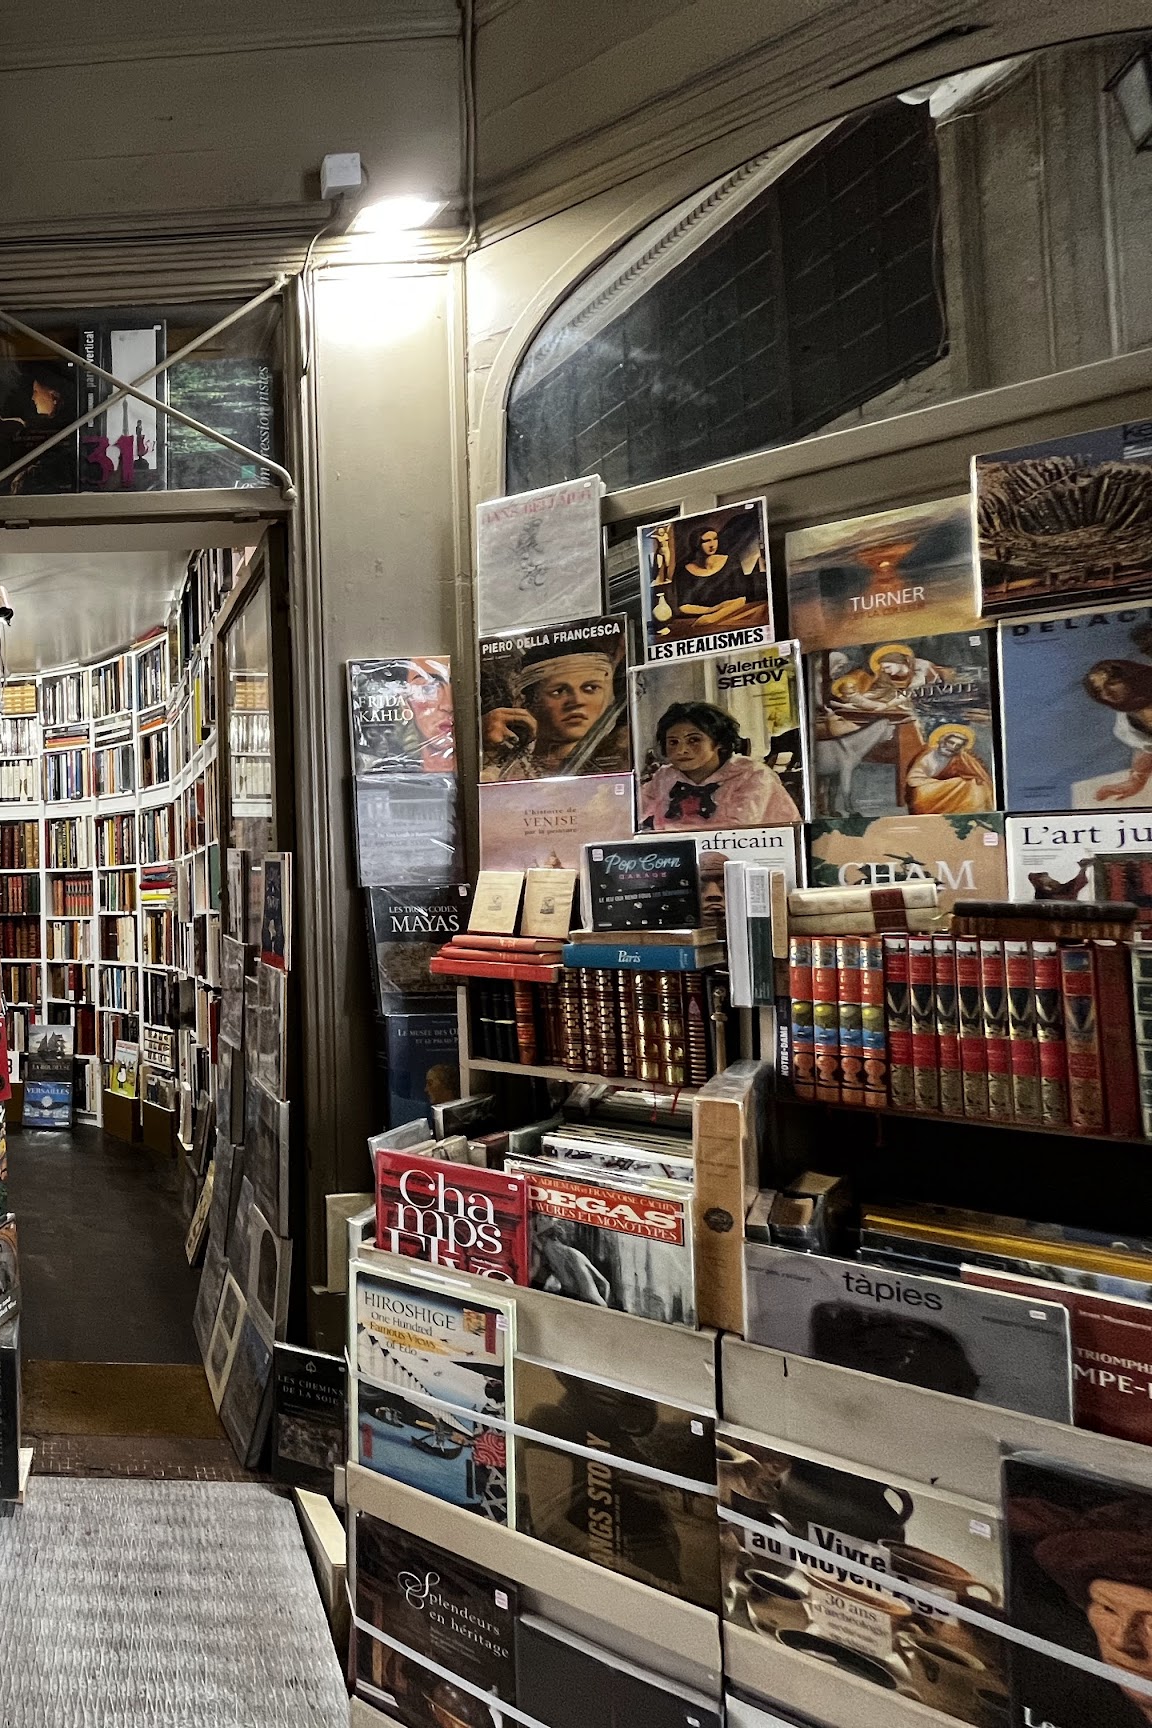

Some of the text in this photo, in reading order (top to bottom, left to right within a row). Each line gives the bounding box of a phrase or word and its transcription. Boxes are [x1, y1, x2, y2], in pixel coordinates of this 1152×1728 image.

[257, 366, 271, 488] imressionnistes
[849, 586, 926, 612] TURNER
[481, 622, 621, 656] PIERO DELLA FRANCESCA
[647, 627, 764, 662] LES REALISMES
[715, 655, 785, 677] Valentin
[717, 668, 785, 690] SEROV
[359, 694, 407, 708] FRIDA
[359, 708, 415, 723] KAHLO
[523, 815, 579, 827] VENISE
[566, 806, 577, 814] de
[701, 832, 785, 851] africain
[1021, 826, 1102, 847] L'art
[604, 852, 681, 875] Pop Corn
[389, 906, 404, 914] LES
[390, 914, 461, 933] MAYAS
[617, 950, 642, 964] Paris
[398, 1029, 407, 1037] LE
[779, 1025, 789, 1078] NOTRE-DAME
[26, 1086, 70, 1095] VERSAILLES
[399, 1169, 499, 1227] Cha
[528, 1185, 678, 1230] DEGAS
[393, 1201, 503, 1256] mps
[578, 1210, 678, 1242] ET MONOTYPES
[842, 1270, 945, 1312] tàpies
[364, 1290, 457, 1332] HIROSHIGE
[369, 1321, 437, 1350] Famous Views
[371, 1311, 433, 1338] One Hundred
[386, 1338, 418, 1357] of Edo
[277, 1373, 345, 1398] LES CHEMINS
[281, 1384, 295, 1396] DE
[298, 1388, 313, 1400] LA
[750, 1530, 782, 1555] au
[813, 1526, 888, 1574] Vivre
[396, 1570, 501, 1636] Splendeurs
[824, 1592, 879, 1622] 30 ans
[428, 1610, 446, 1625] en
[450, 1617, 510, 1659] héritage
